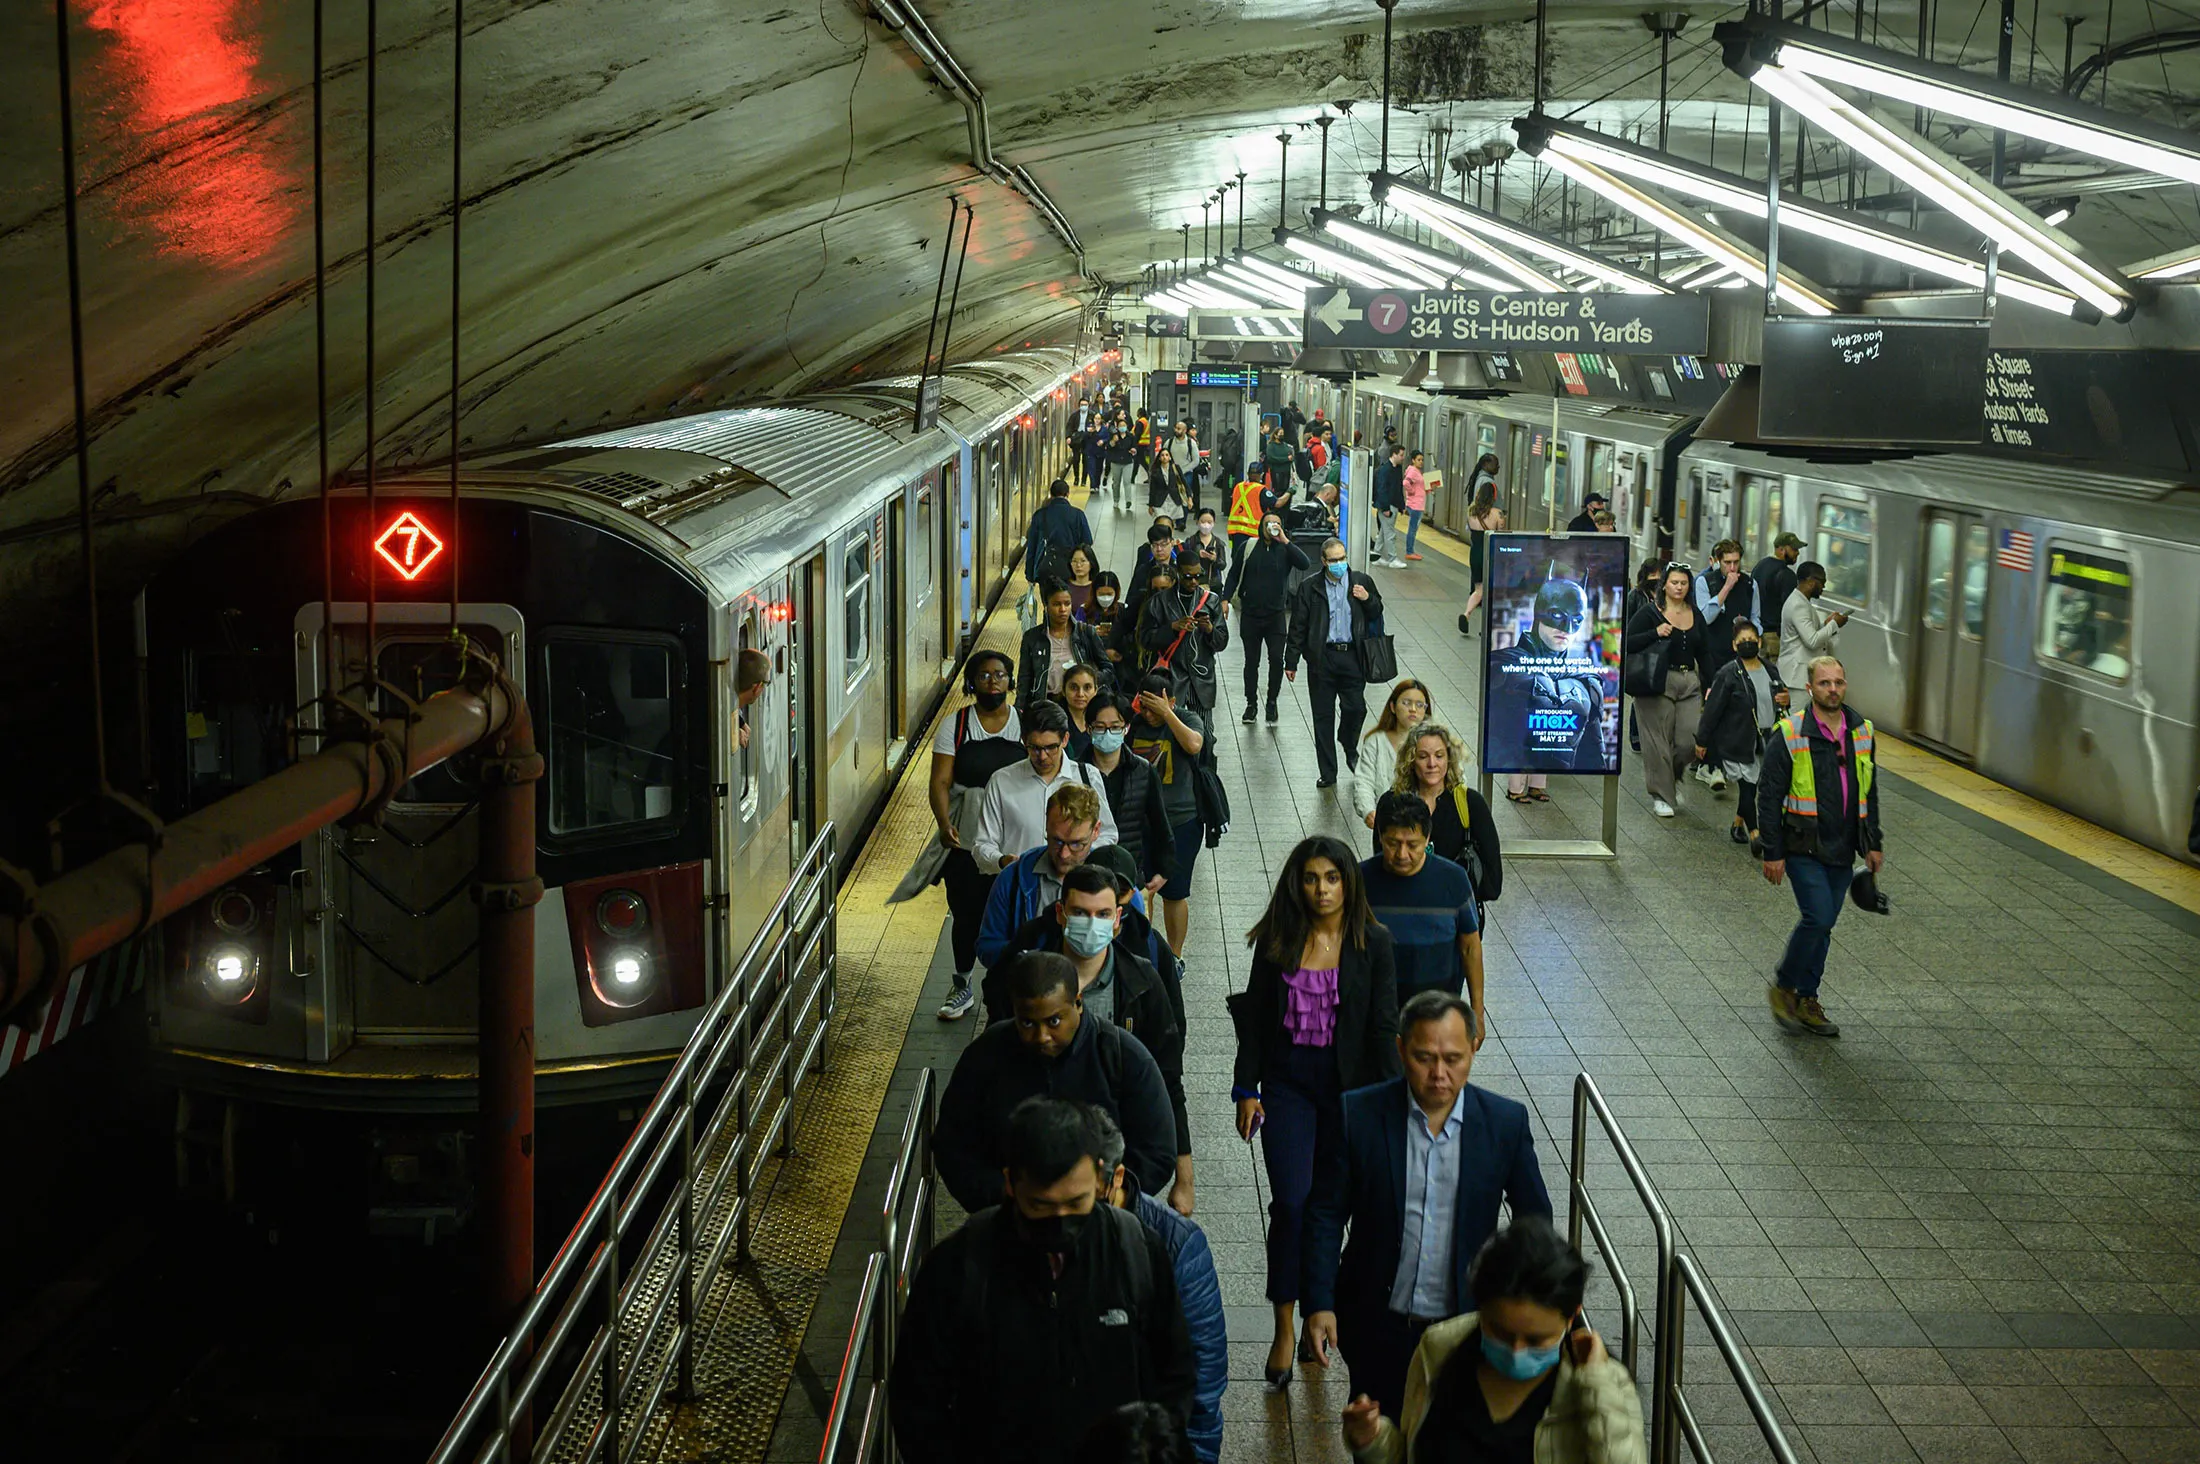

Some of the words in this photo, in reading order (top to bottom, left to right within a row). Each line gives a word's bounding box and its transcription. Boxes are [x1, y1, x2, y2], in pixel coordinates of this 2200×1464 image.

[1380, 303, 1397, 326] 7
[1411, 293, 1481, 316] Javits
[1489, 294, 1570, 318] Center
[1579, 297, 1596, 318] &
[1410, 317, 1443, 339] 34
[1452, 318, 1580, 342] St-Hudson
[1589, 319, 1653, 344] Yards
[1843, 349, 1865, 364] Sign
[1993, 352, 2032, 378] Square
[1998, 376, 2035, 399] Street-
[2016, 401, 2049, 424] Yards
[1991, 422, 2004, 443] all
[2001, 424, 2032, 446] times
[396, 526, 420, 566] 7
[1502, 664, 1526, 673] when
[1527, 665, 1543, 675] you
[1544, 665, 1566, 673] need
[1567, 665, 1577, 673] to
[1578, 664, 1609, 673] believe
[1519, 656, 1534, 664] the
[1553, 656, 1563, 664] to
[1564, 656, 1592, 664] watch
[1528, 714, 1578, 729] max
